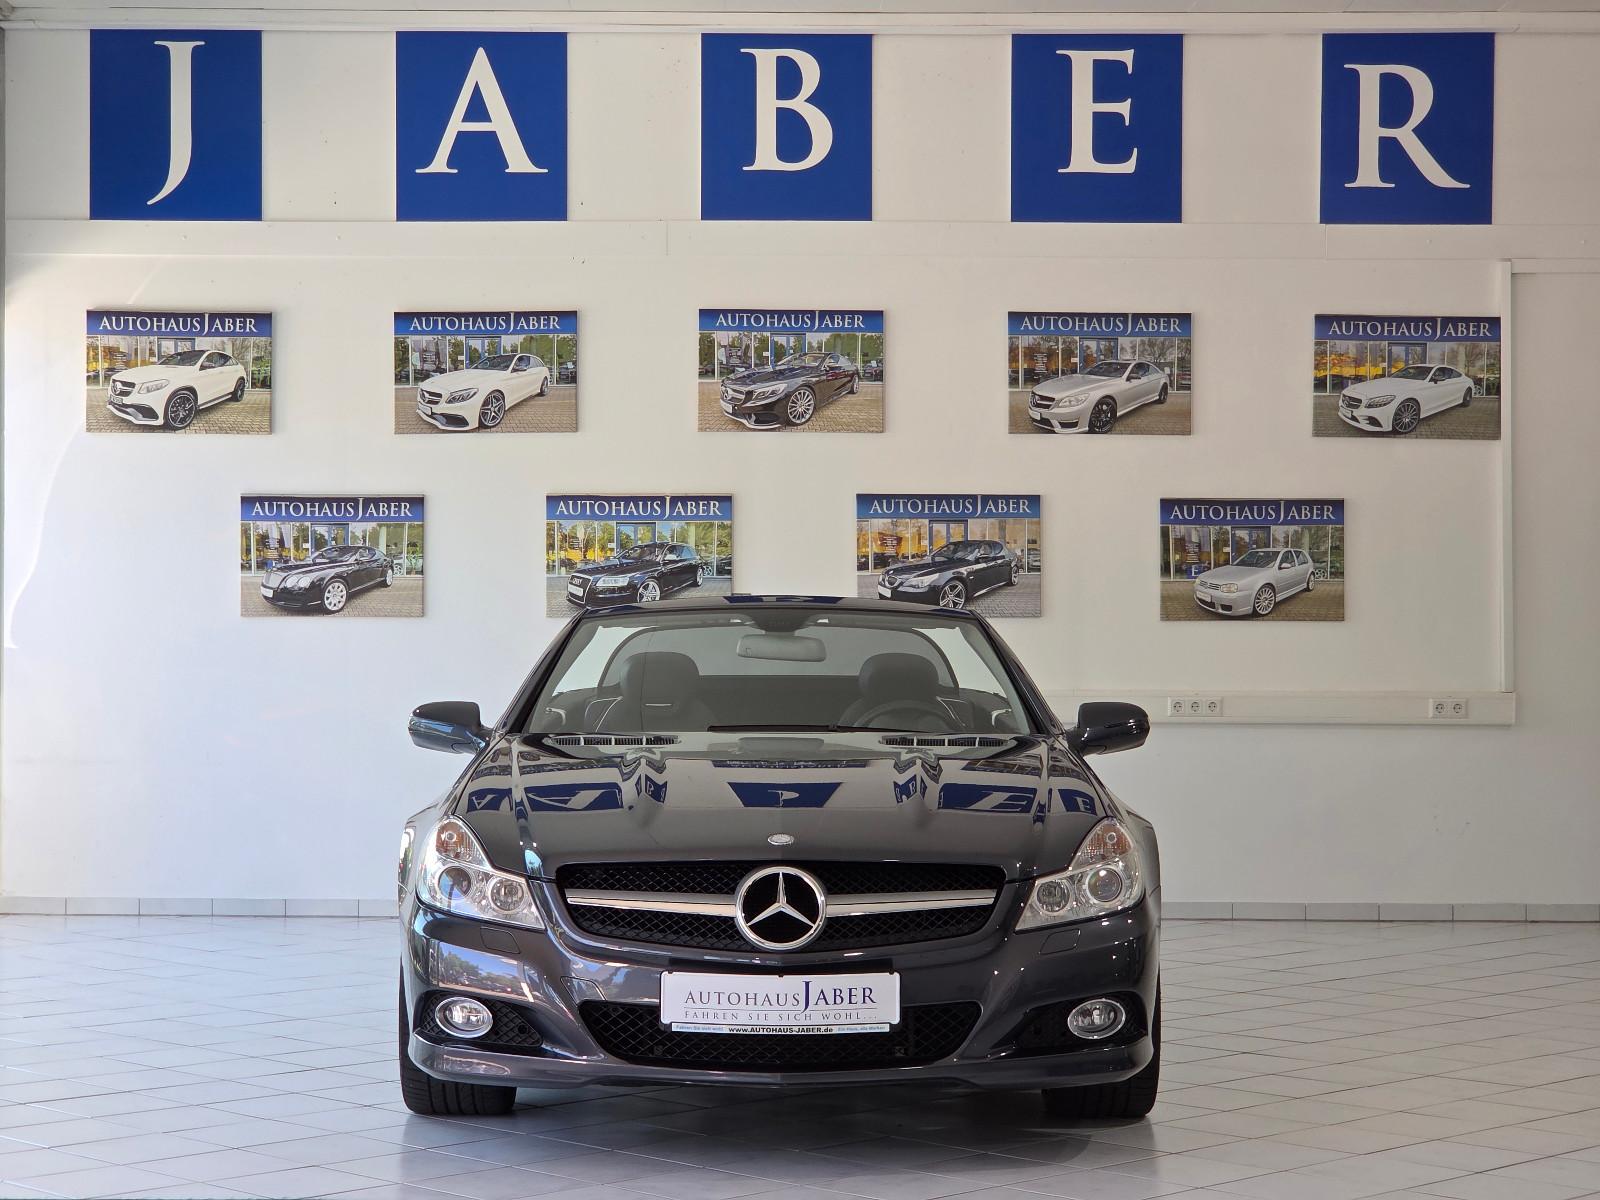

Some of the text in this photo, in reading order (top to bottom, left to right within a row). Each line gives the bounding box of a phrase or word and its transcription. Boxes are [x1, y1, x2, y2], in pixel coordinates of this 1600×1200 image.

[684, 1011, 738, 1020] FAHREN
[748, 1012, 768, 1021] SIE
[778, 1013, 812, 1021] SICH
[728, 1026, 833, 1034] www.AUTOHAUS-JABER.de
